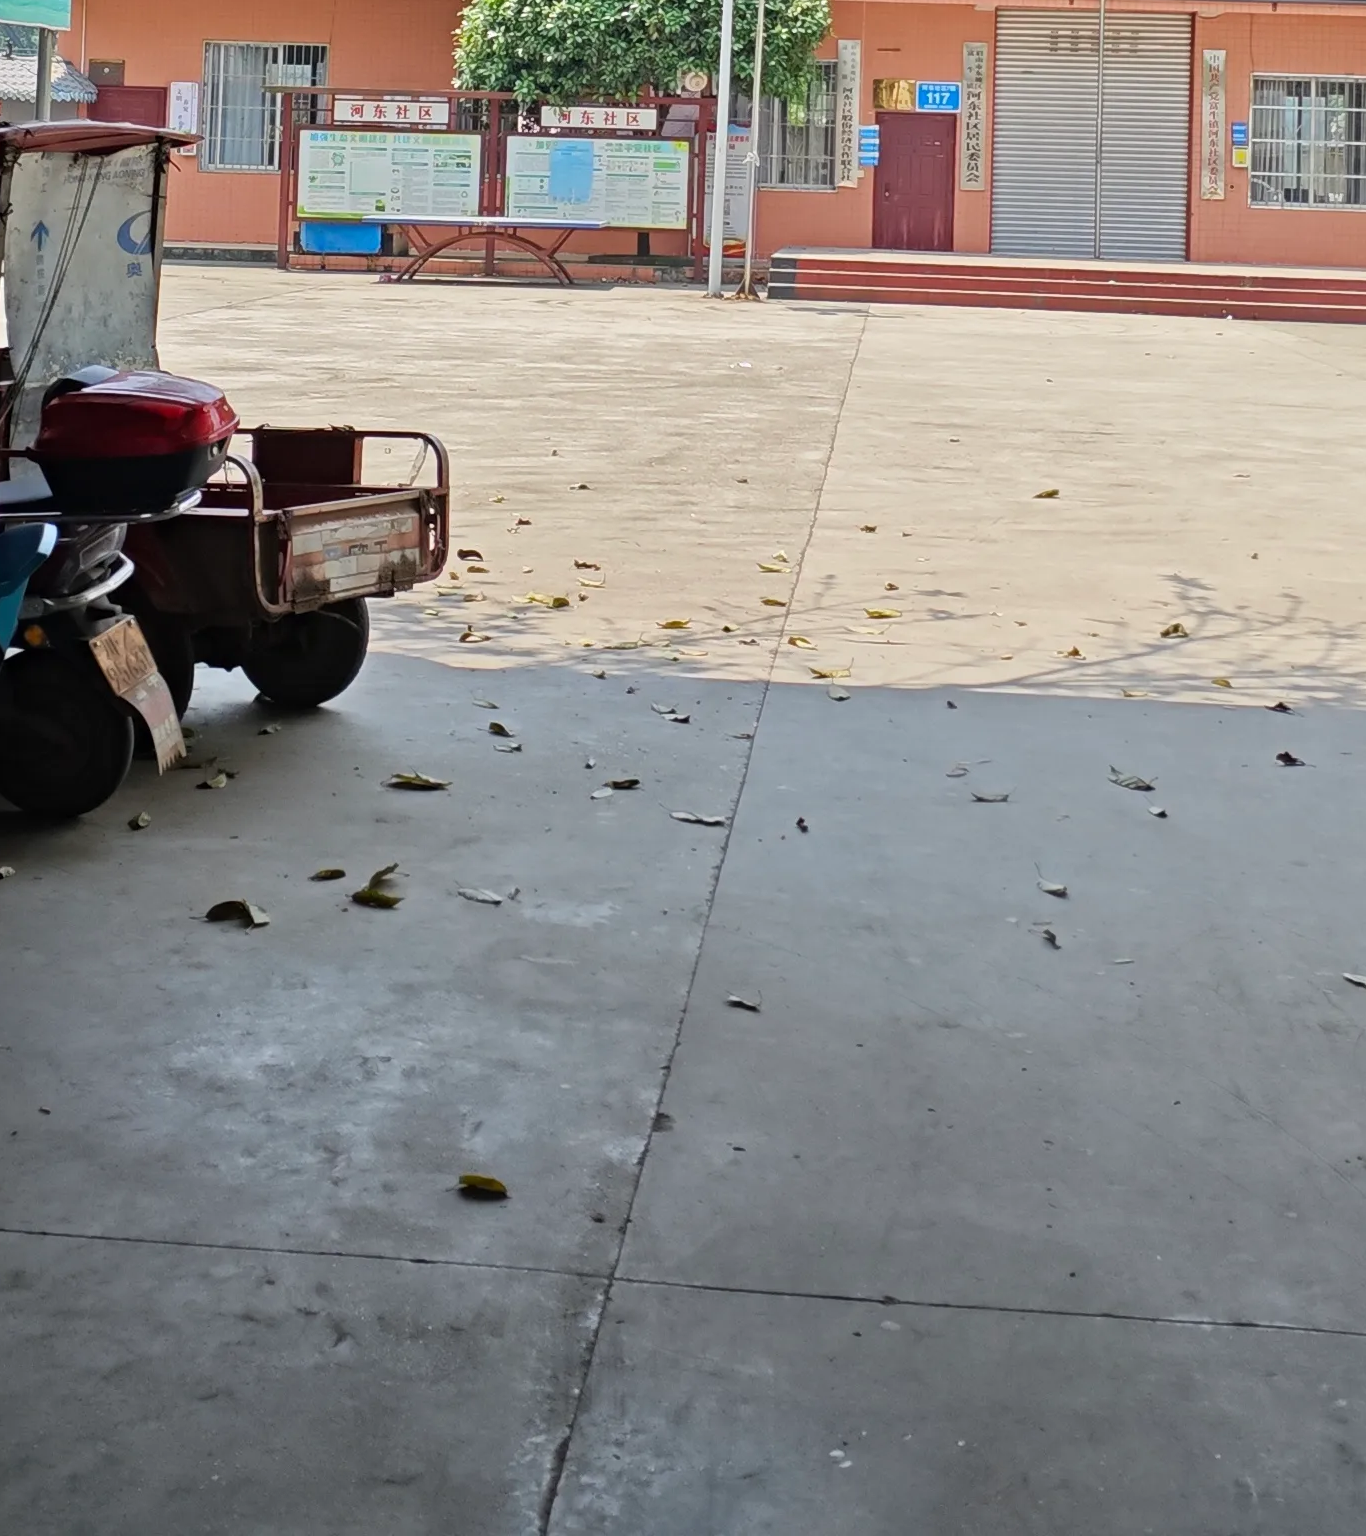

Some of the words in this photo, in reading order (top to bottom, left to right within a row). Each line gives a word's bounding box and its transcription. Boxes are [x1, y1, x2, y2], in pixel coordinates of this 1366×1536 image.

[926, 92, 951, 105] 117
[350, 103, 433, 120] 河东社区
[557, 110, 641, 127] 河东社区
[126, 262, 143, 279] 奥
